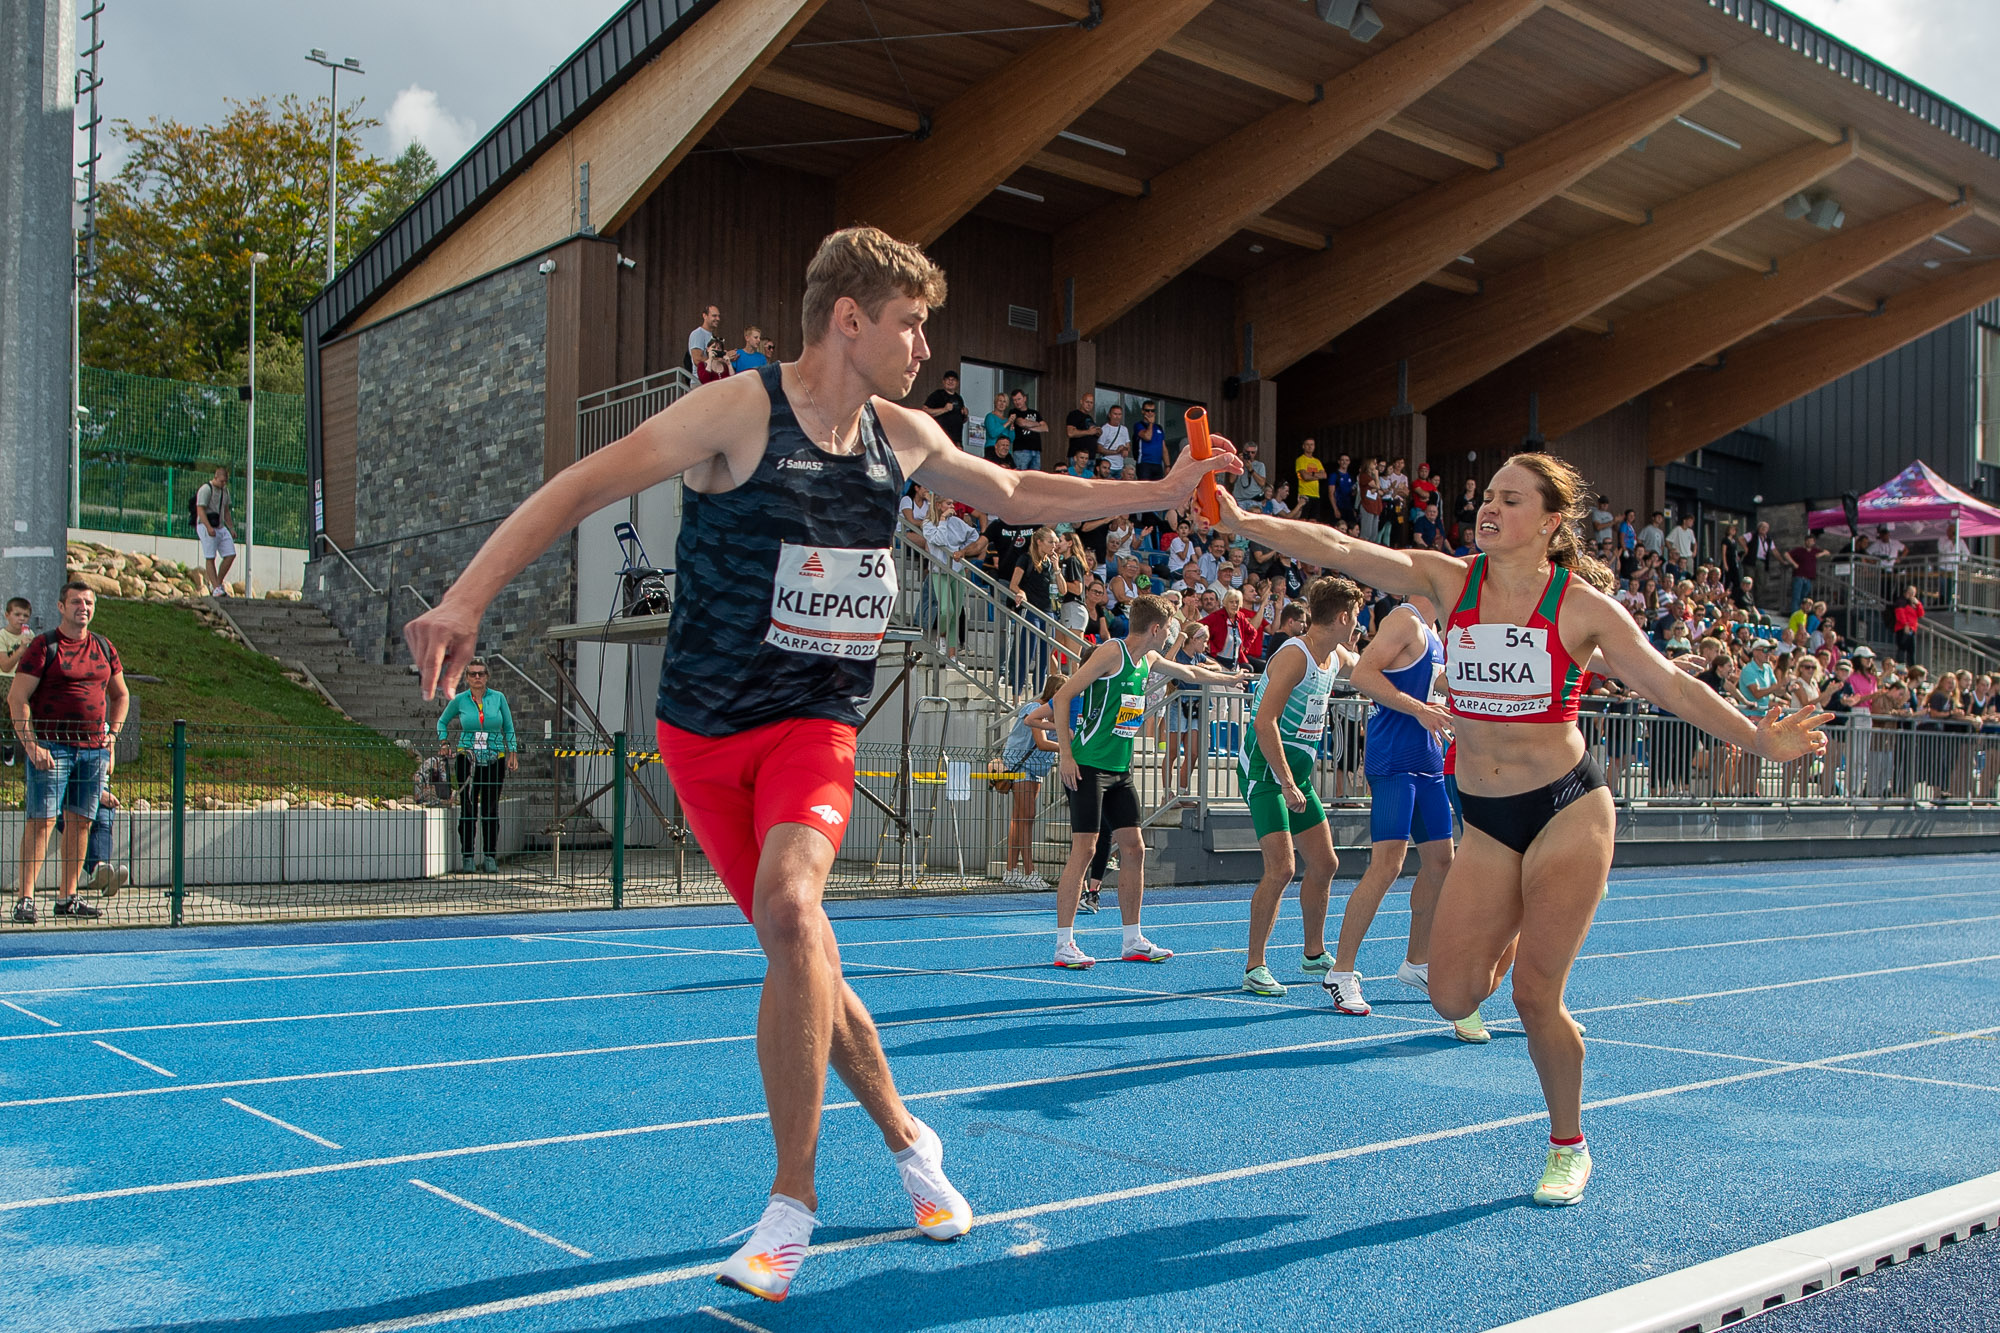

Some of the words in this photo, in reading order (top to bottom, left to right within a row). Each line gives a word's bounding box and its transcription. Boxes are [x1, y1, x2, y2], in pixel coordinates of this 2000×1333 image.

[786, 459, 824, 471] SaMASZ
[798, 571, 825, 579] KARPACZ
[857, 554, 886, 579] 56
[776, 586, 893, 619] KLEPACKI
[772, 630, 842, 655] KARPACZ
[844, 644, 876, 656] 2022
[1505, 627, 1534, 648] 54
[1456, 661, 1535, 684] JELSKA
[1505, 700, 1536, 714] 2022
[810, 804, 845, 825] 4F
